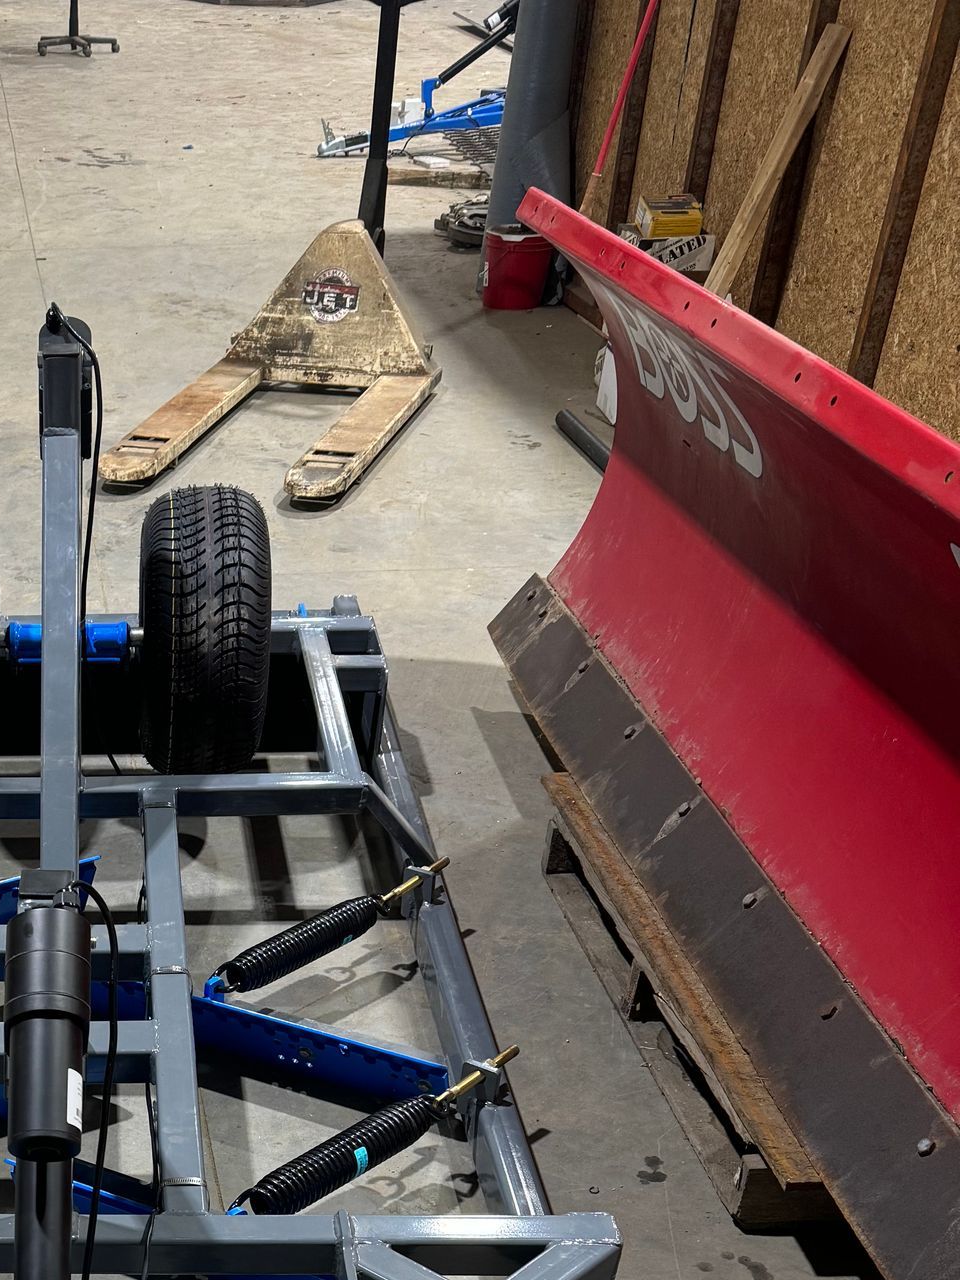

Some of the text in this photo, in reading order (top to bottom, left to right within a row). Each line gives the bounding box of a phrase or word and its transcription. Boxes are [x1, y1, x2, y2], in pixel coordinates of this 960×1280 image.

[657, 235, 707, 264] LATED
[304, 287, 356, 310] JET
[602, 285, 763, 479] BOSS
